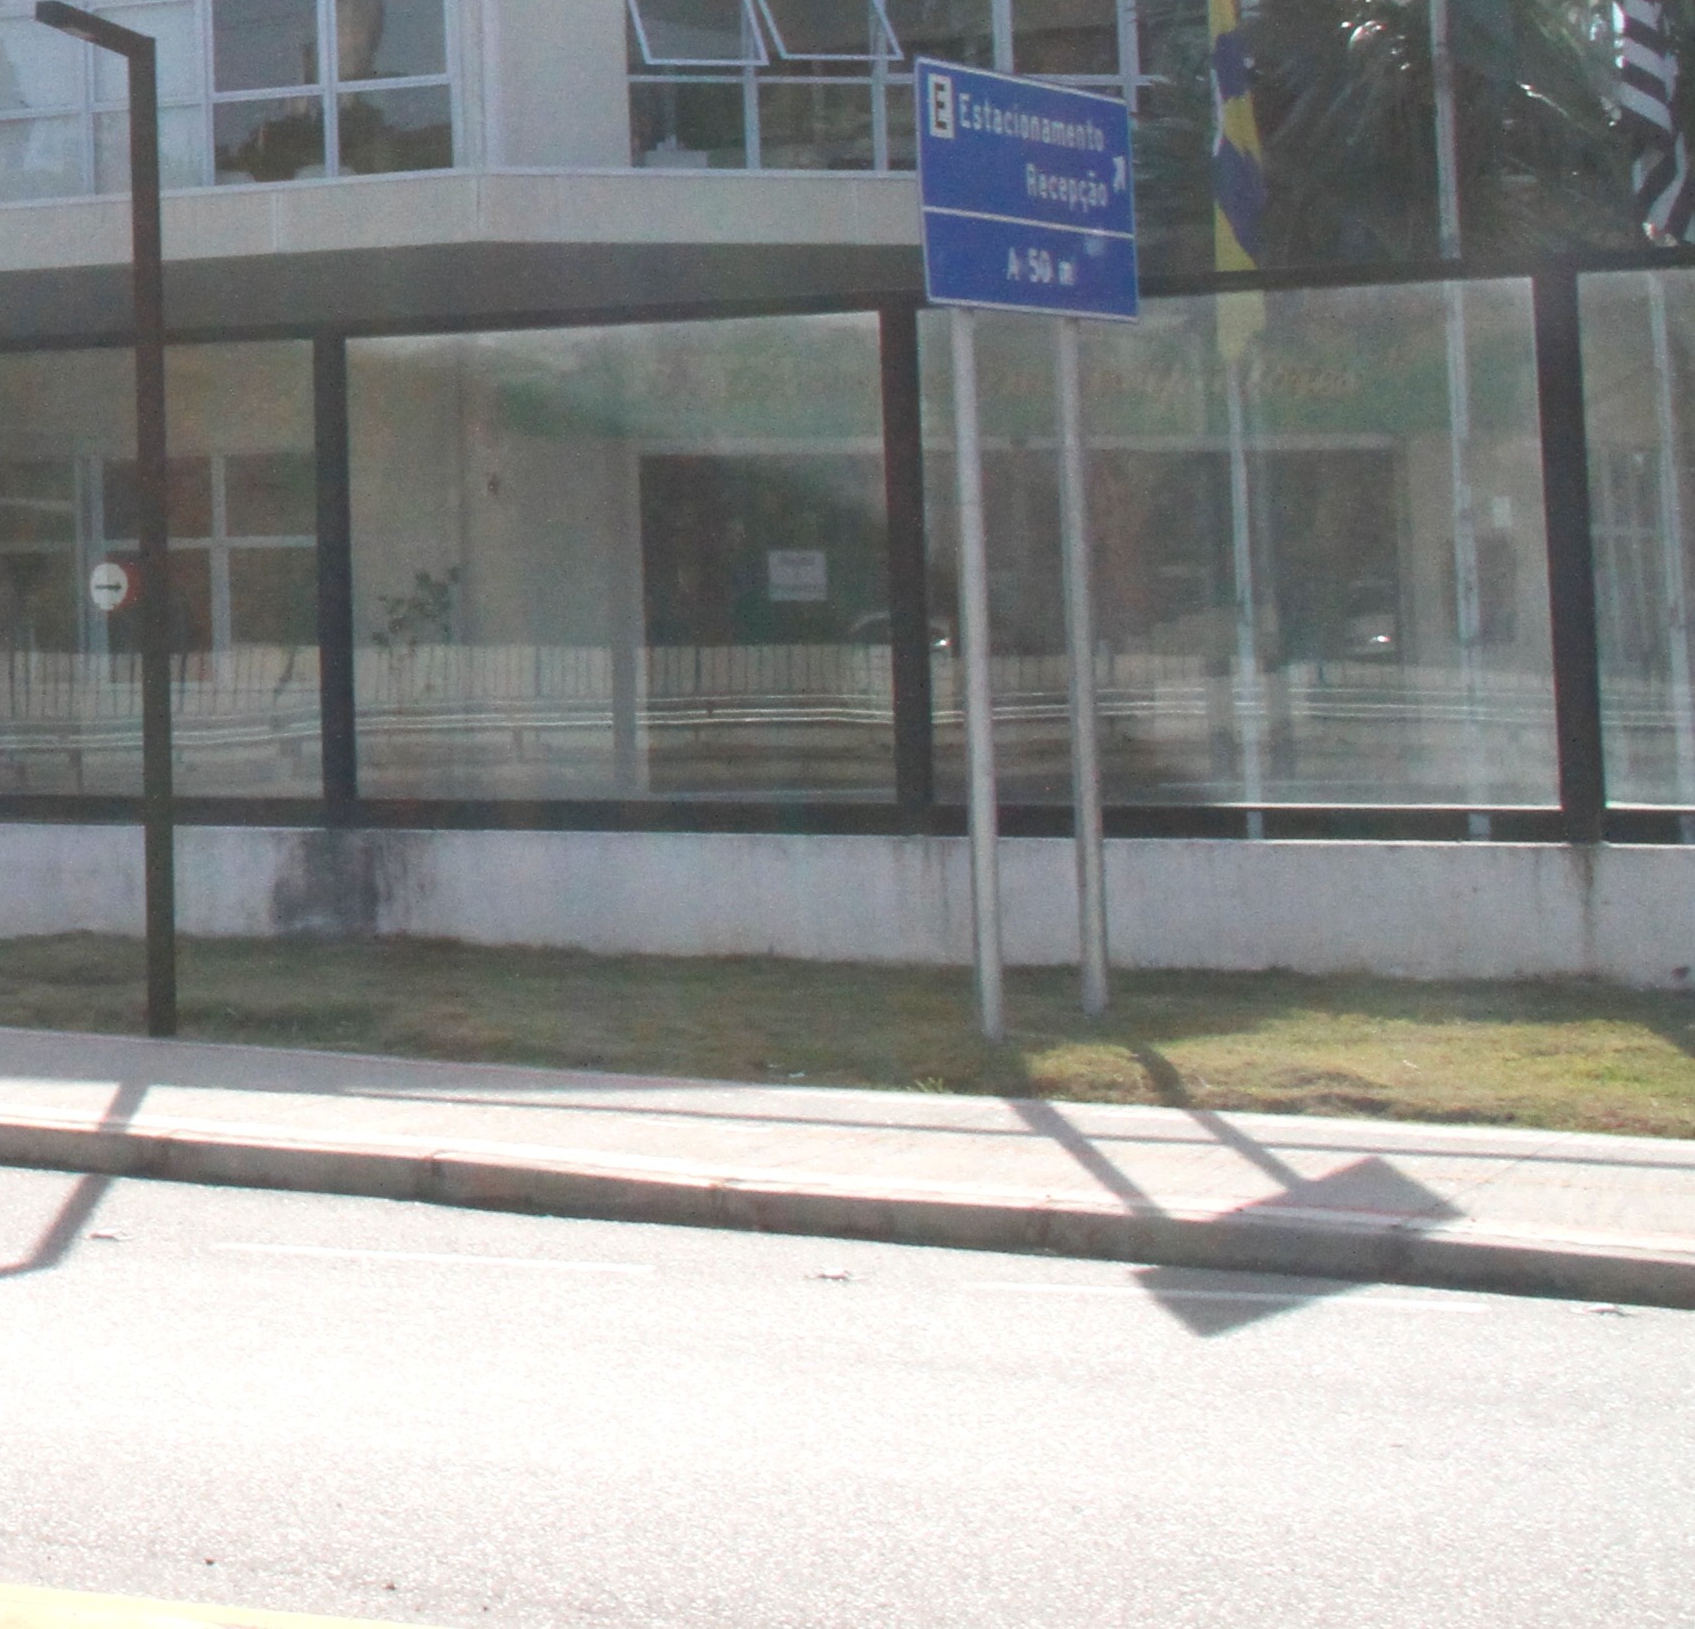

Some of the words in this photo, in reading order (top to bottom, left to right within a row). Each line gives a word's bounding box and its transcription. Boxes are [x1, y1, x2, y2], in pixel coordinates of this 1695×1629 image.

[959, 92, 1105, 152] Estacionamento
[1026, 162, 1108, 213] Recepção
[1006, 246, 1020, 281] A
